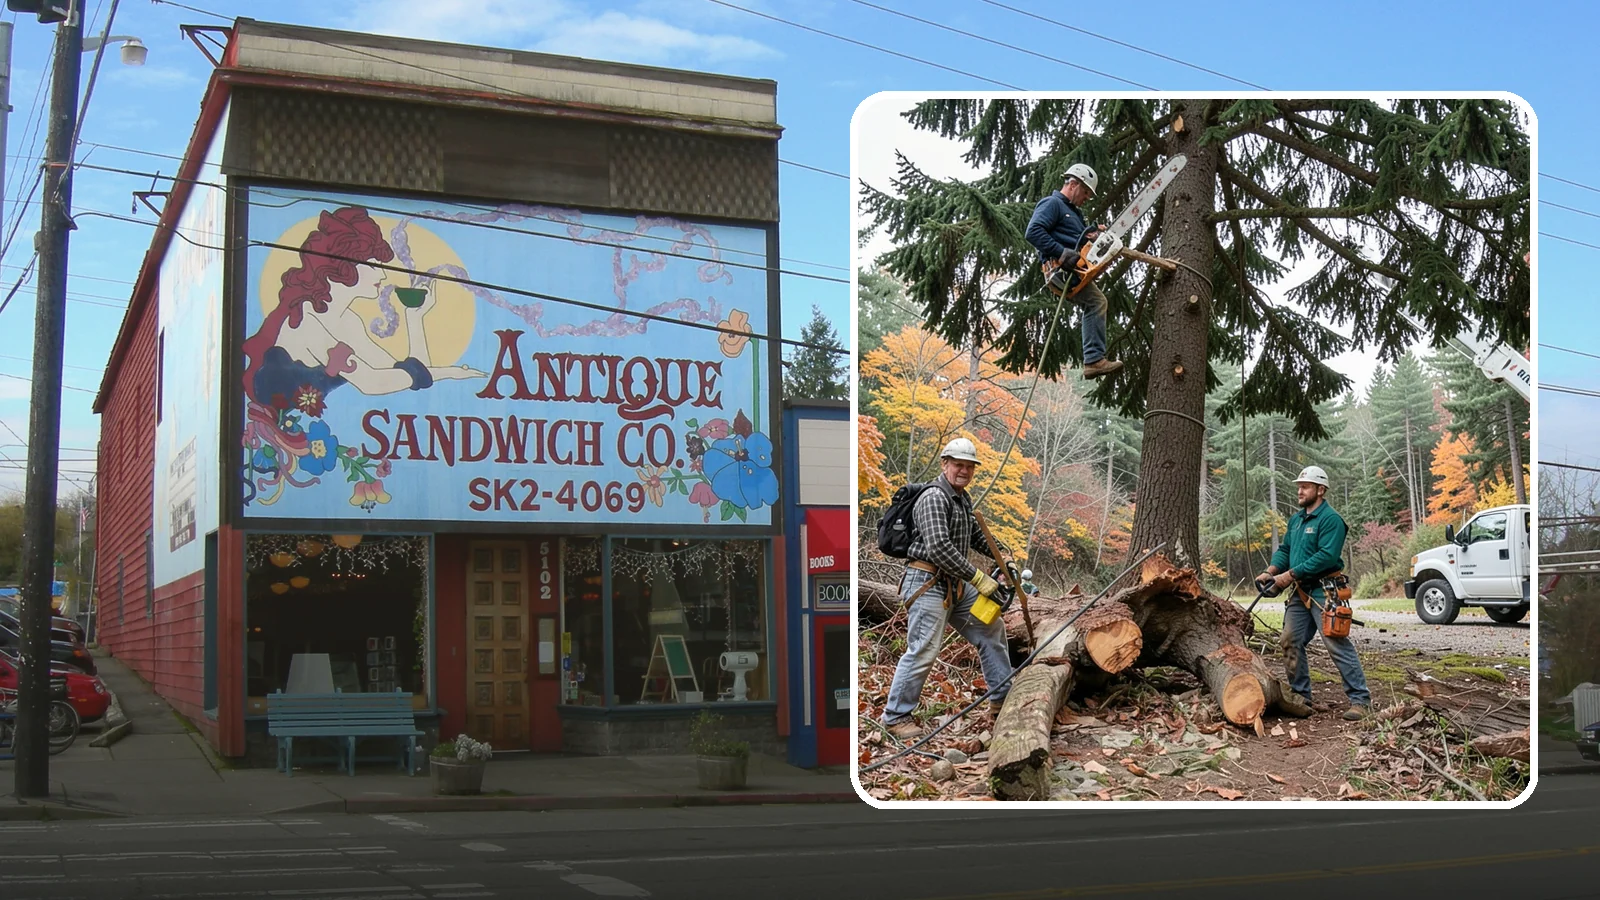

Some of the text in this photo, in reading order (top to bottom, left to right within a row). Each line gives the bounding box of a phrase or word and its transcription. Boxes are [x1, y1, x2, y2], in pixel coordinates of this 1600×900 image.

[475, 329, 724, 421] ANTIQUE
[361, 408, 685, 468] SANDWICH CO.
[468, 477, 646, 513] SK2-4069
[540, 541, 551, 599] 5102
[809, 555, 834, 569] BOOKS
